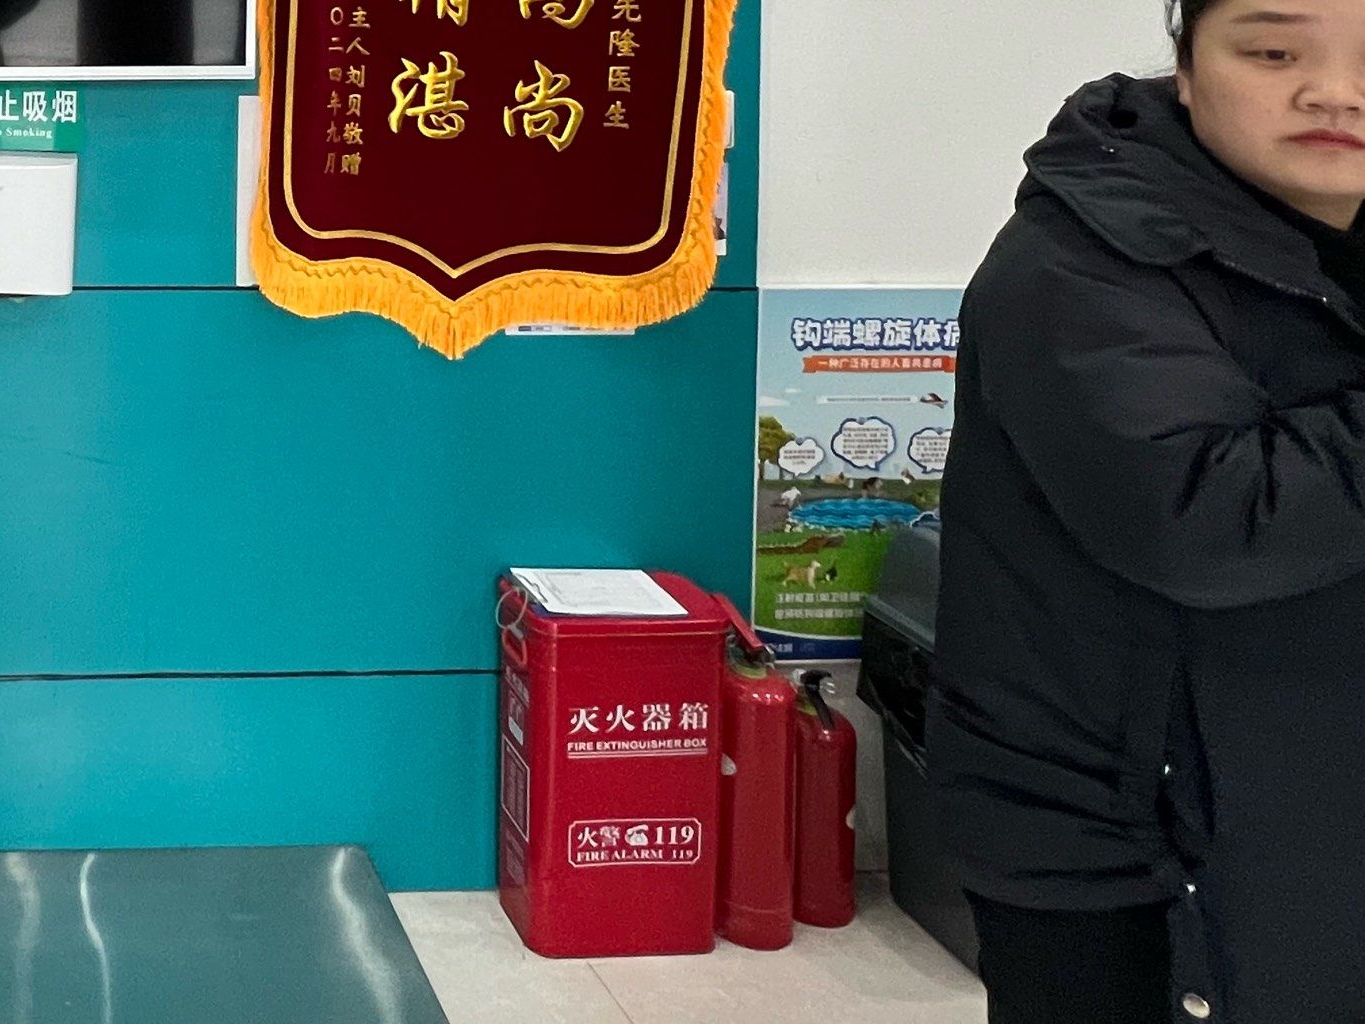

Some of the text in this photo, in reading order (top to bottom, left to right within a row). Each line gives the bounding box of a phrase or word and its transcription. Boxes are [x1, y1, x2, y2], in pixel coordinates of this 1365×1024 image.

[5, 127, 53, 139] Smoking
[566, 702, 709, 736] 灭火器箱
[567, 738, 707, 752] FIRE EXTINGUISHER BOX
[577, 825, 695, 848] 火警 119
[576, 849, 693, 863] FIRE ALARM 119
